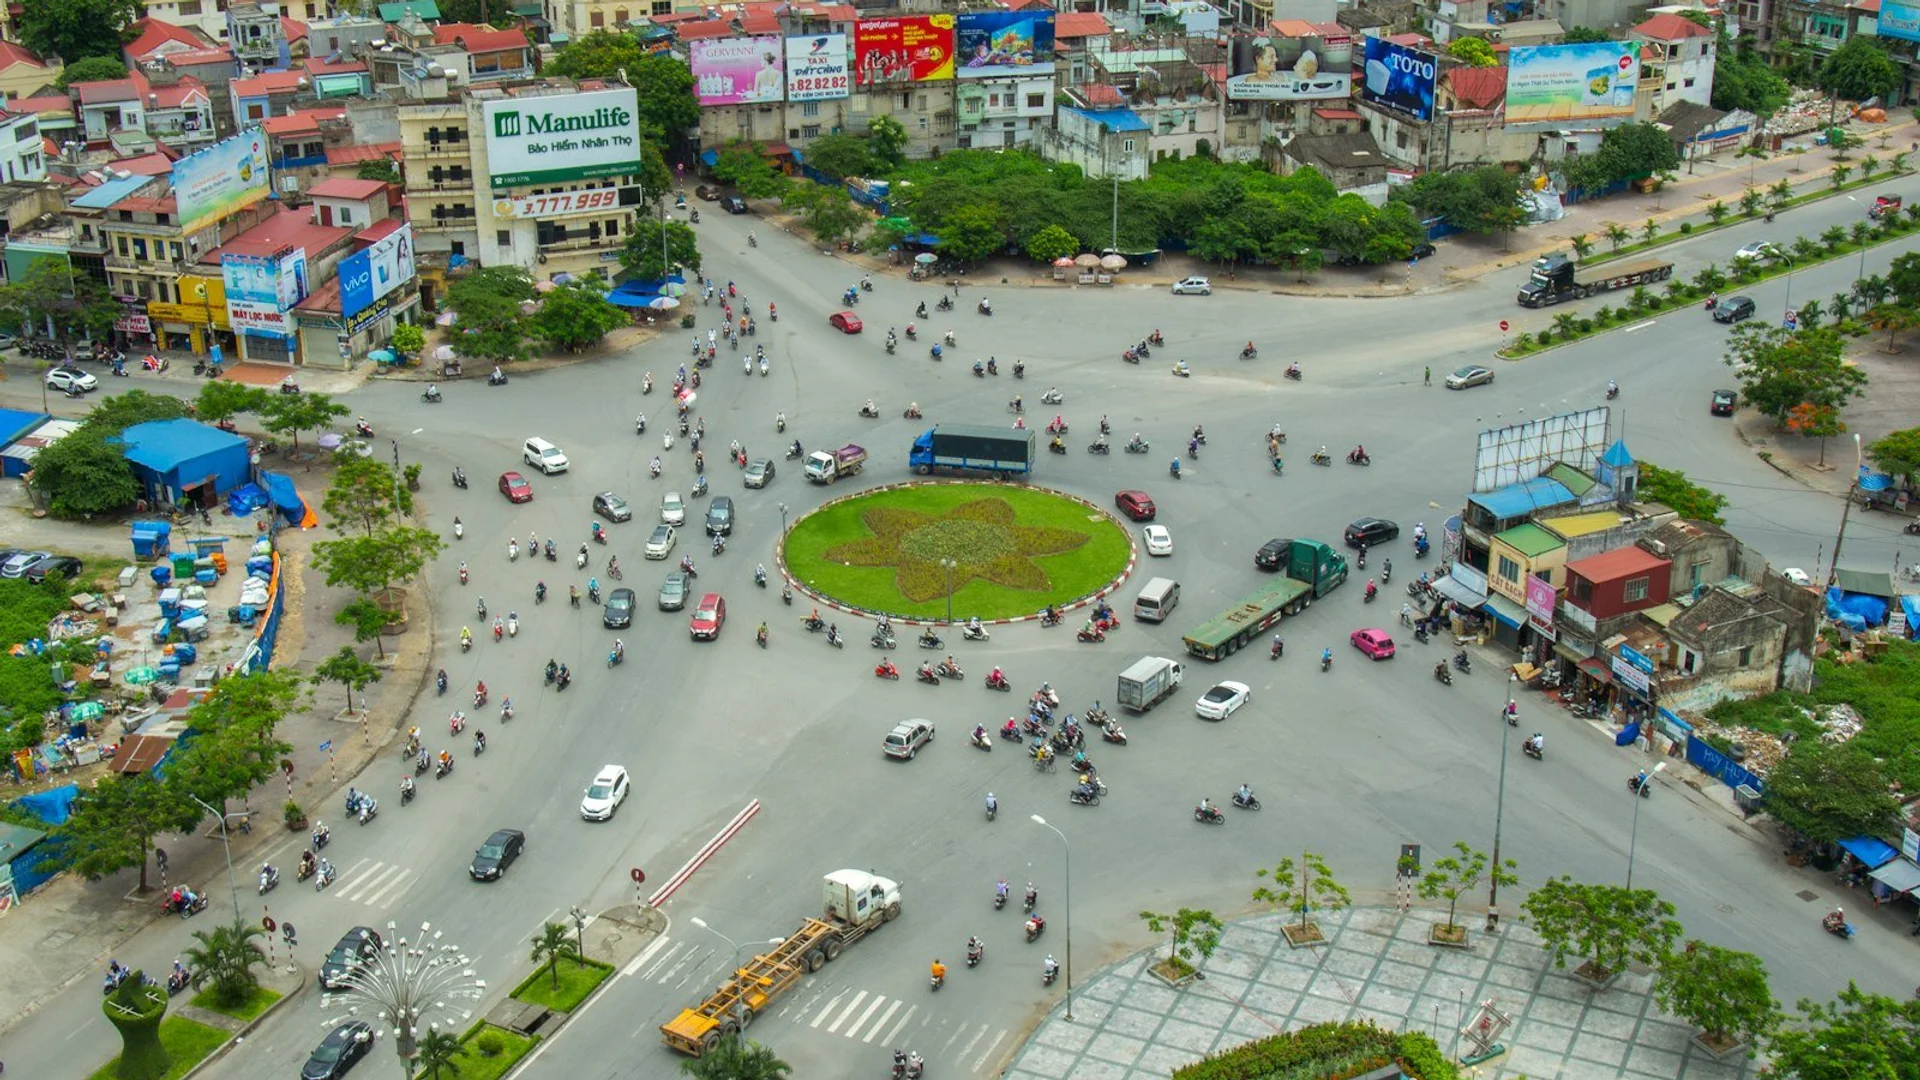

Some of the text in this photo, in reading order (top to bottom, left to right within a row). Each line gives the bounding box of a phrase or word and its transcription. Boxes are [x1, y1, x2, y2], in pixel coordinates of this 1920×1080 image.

[808, 57, 827, 65] TAXI
[1391, 53, 1434, 80] TOTO
[526, 107, 631, 135] Manulife
[527, 135, 632, 155] Bảo Hiểm Nhân Thọ
[523, 190, 616, 215] 3.777.999
[344, 271, 369, 292] vivo
[232, 309, 284, 323] MÁY LỌC NƯỚC
